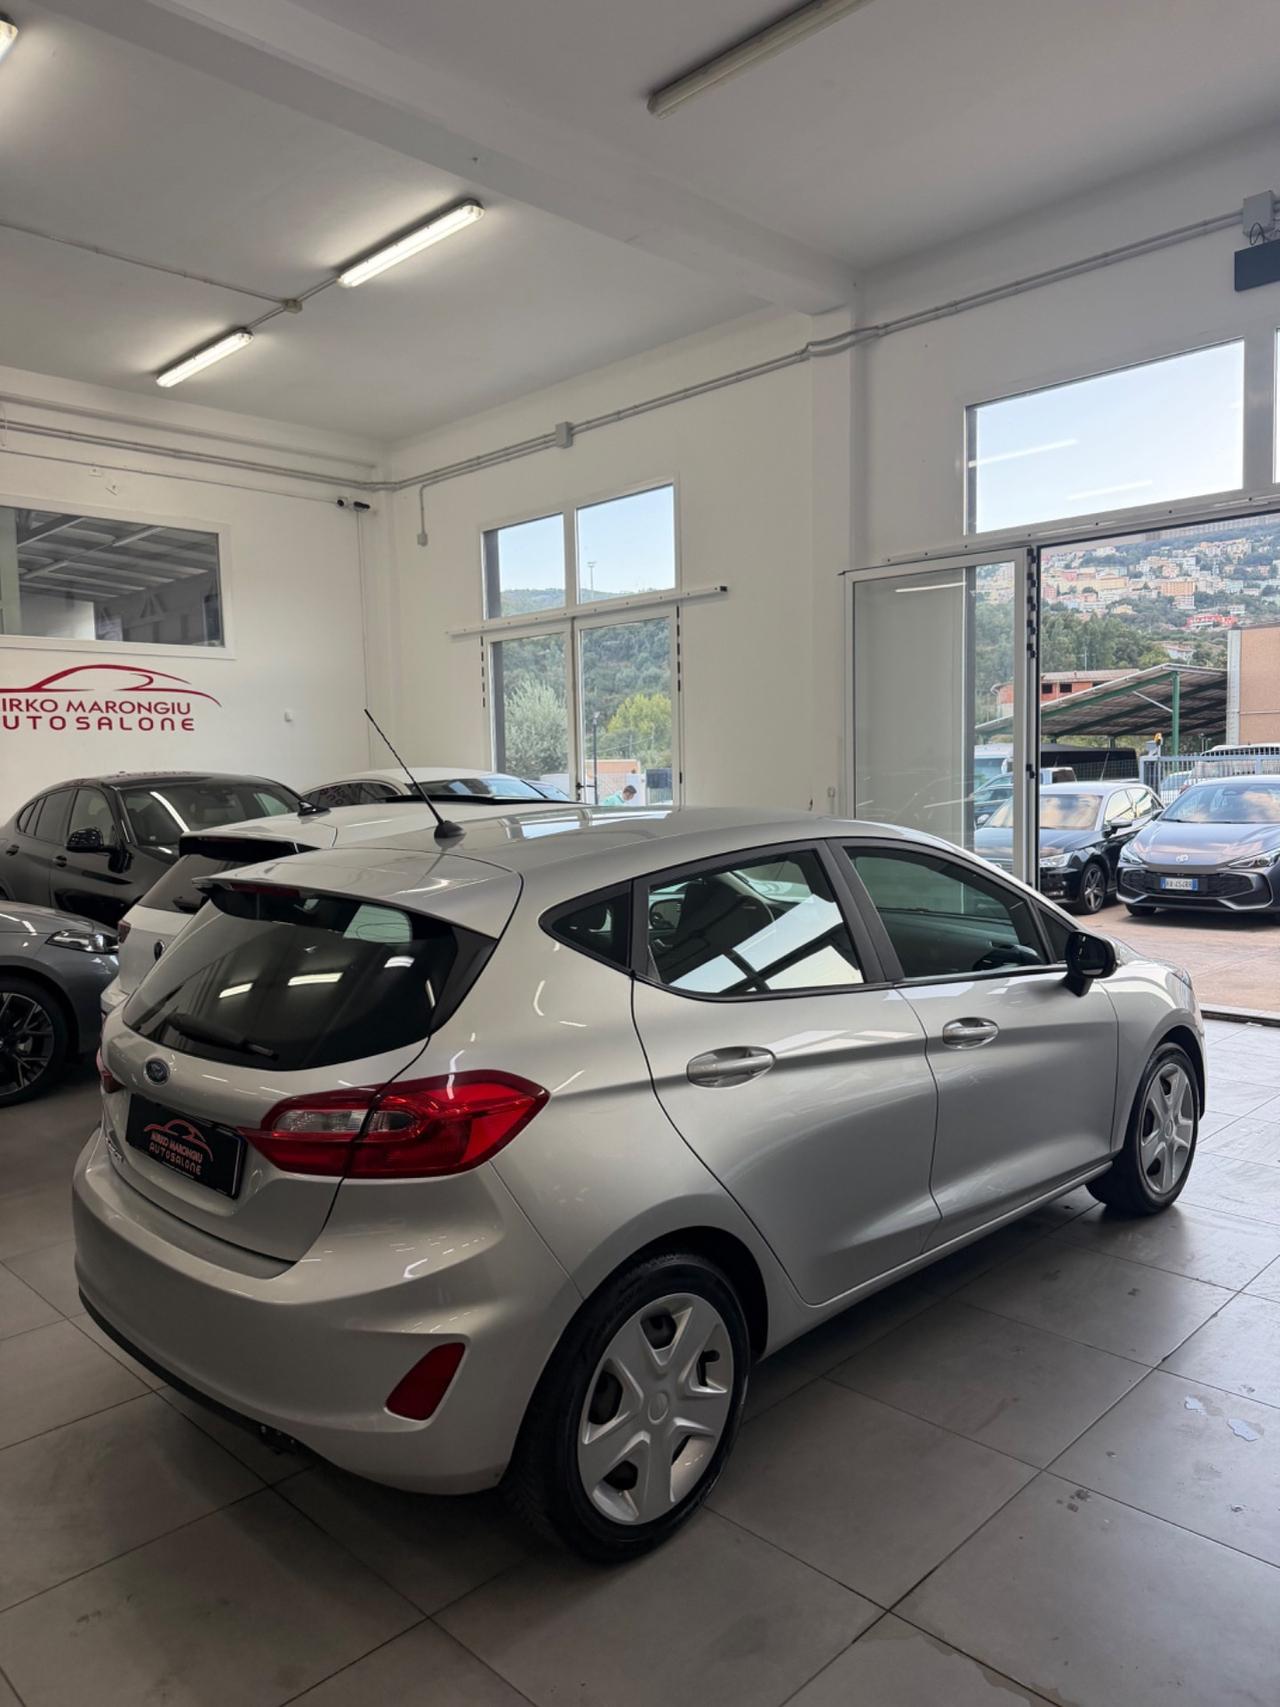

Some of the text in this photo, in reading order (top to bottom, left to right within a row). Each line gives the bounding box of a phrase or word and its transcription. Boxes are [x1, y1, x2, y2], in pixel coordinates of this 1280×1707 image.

[1, 698, 191, 715] IRKO MARONGIU
[1, 715, 195, 731] UTOSALONE
[149, 1141, 202, 1175] AUTOSALONE
